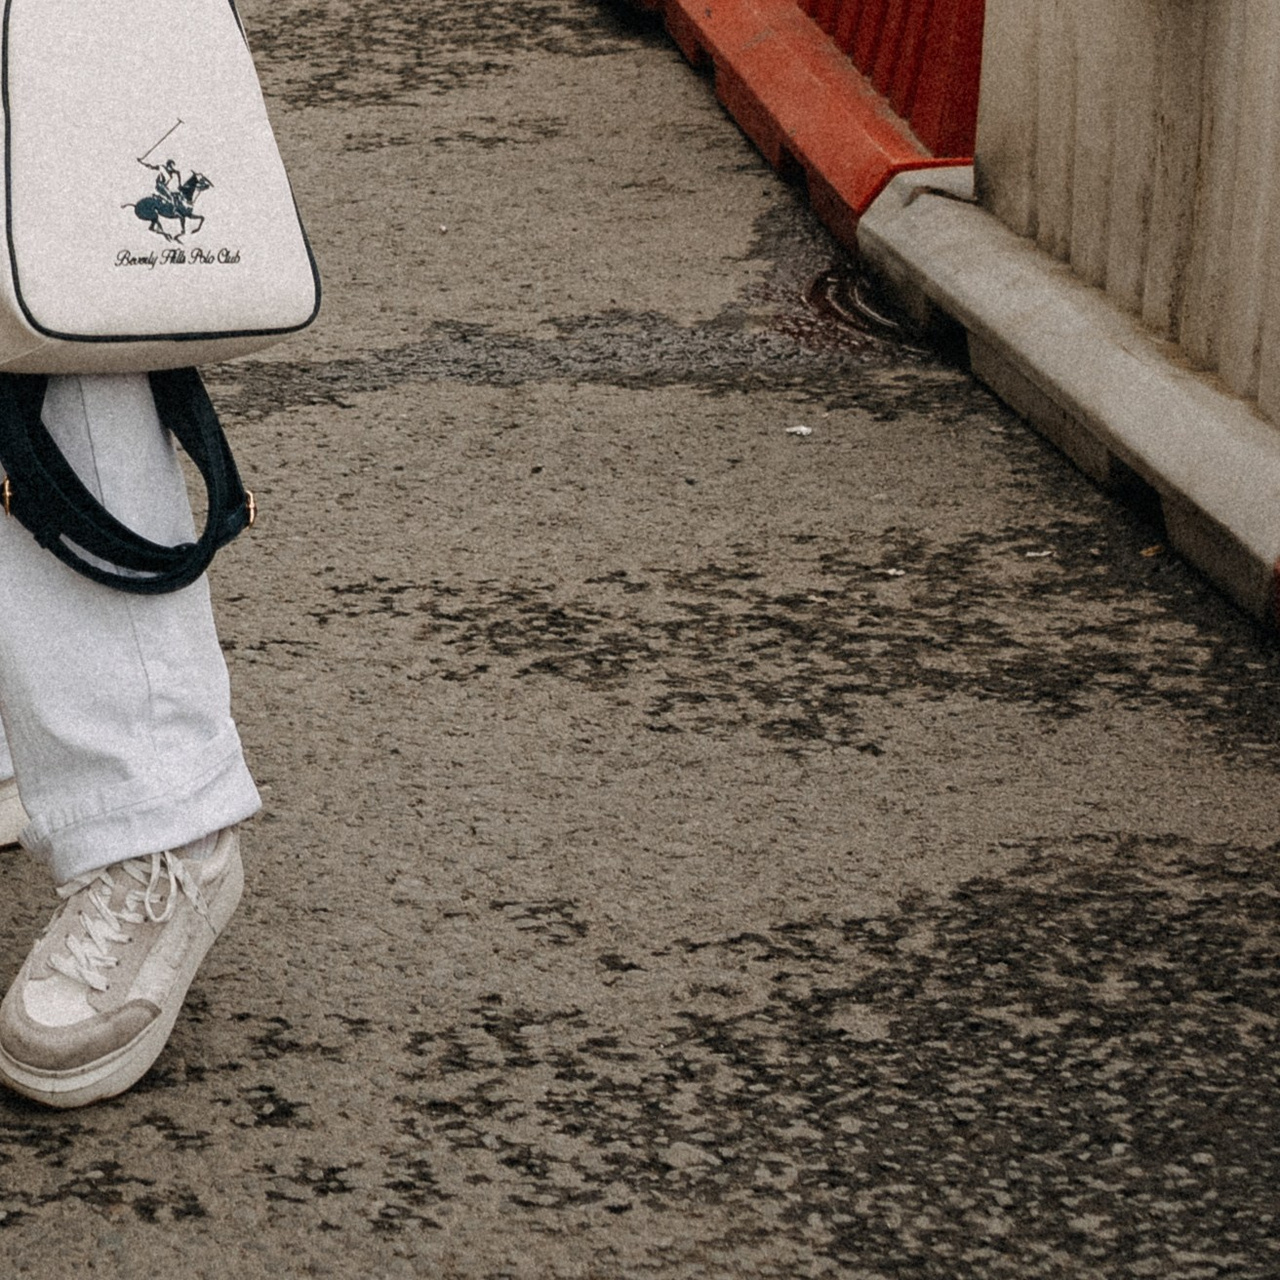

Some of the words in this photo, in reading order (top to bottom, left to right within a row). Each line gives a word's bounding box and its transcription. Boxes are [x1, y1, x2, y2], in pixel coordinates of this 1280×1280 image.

[114, 249, 158, 271] Beverly
[159, 247, 187, 266] Hills
[187, 247, 216, 265] Polo
[217, 247, 241, 265] Club
